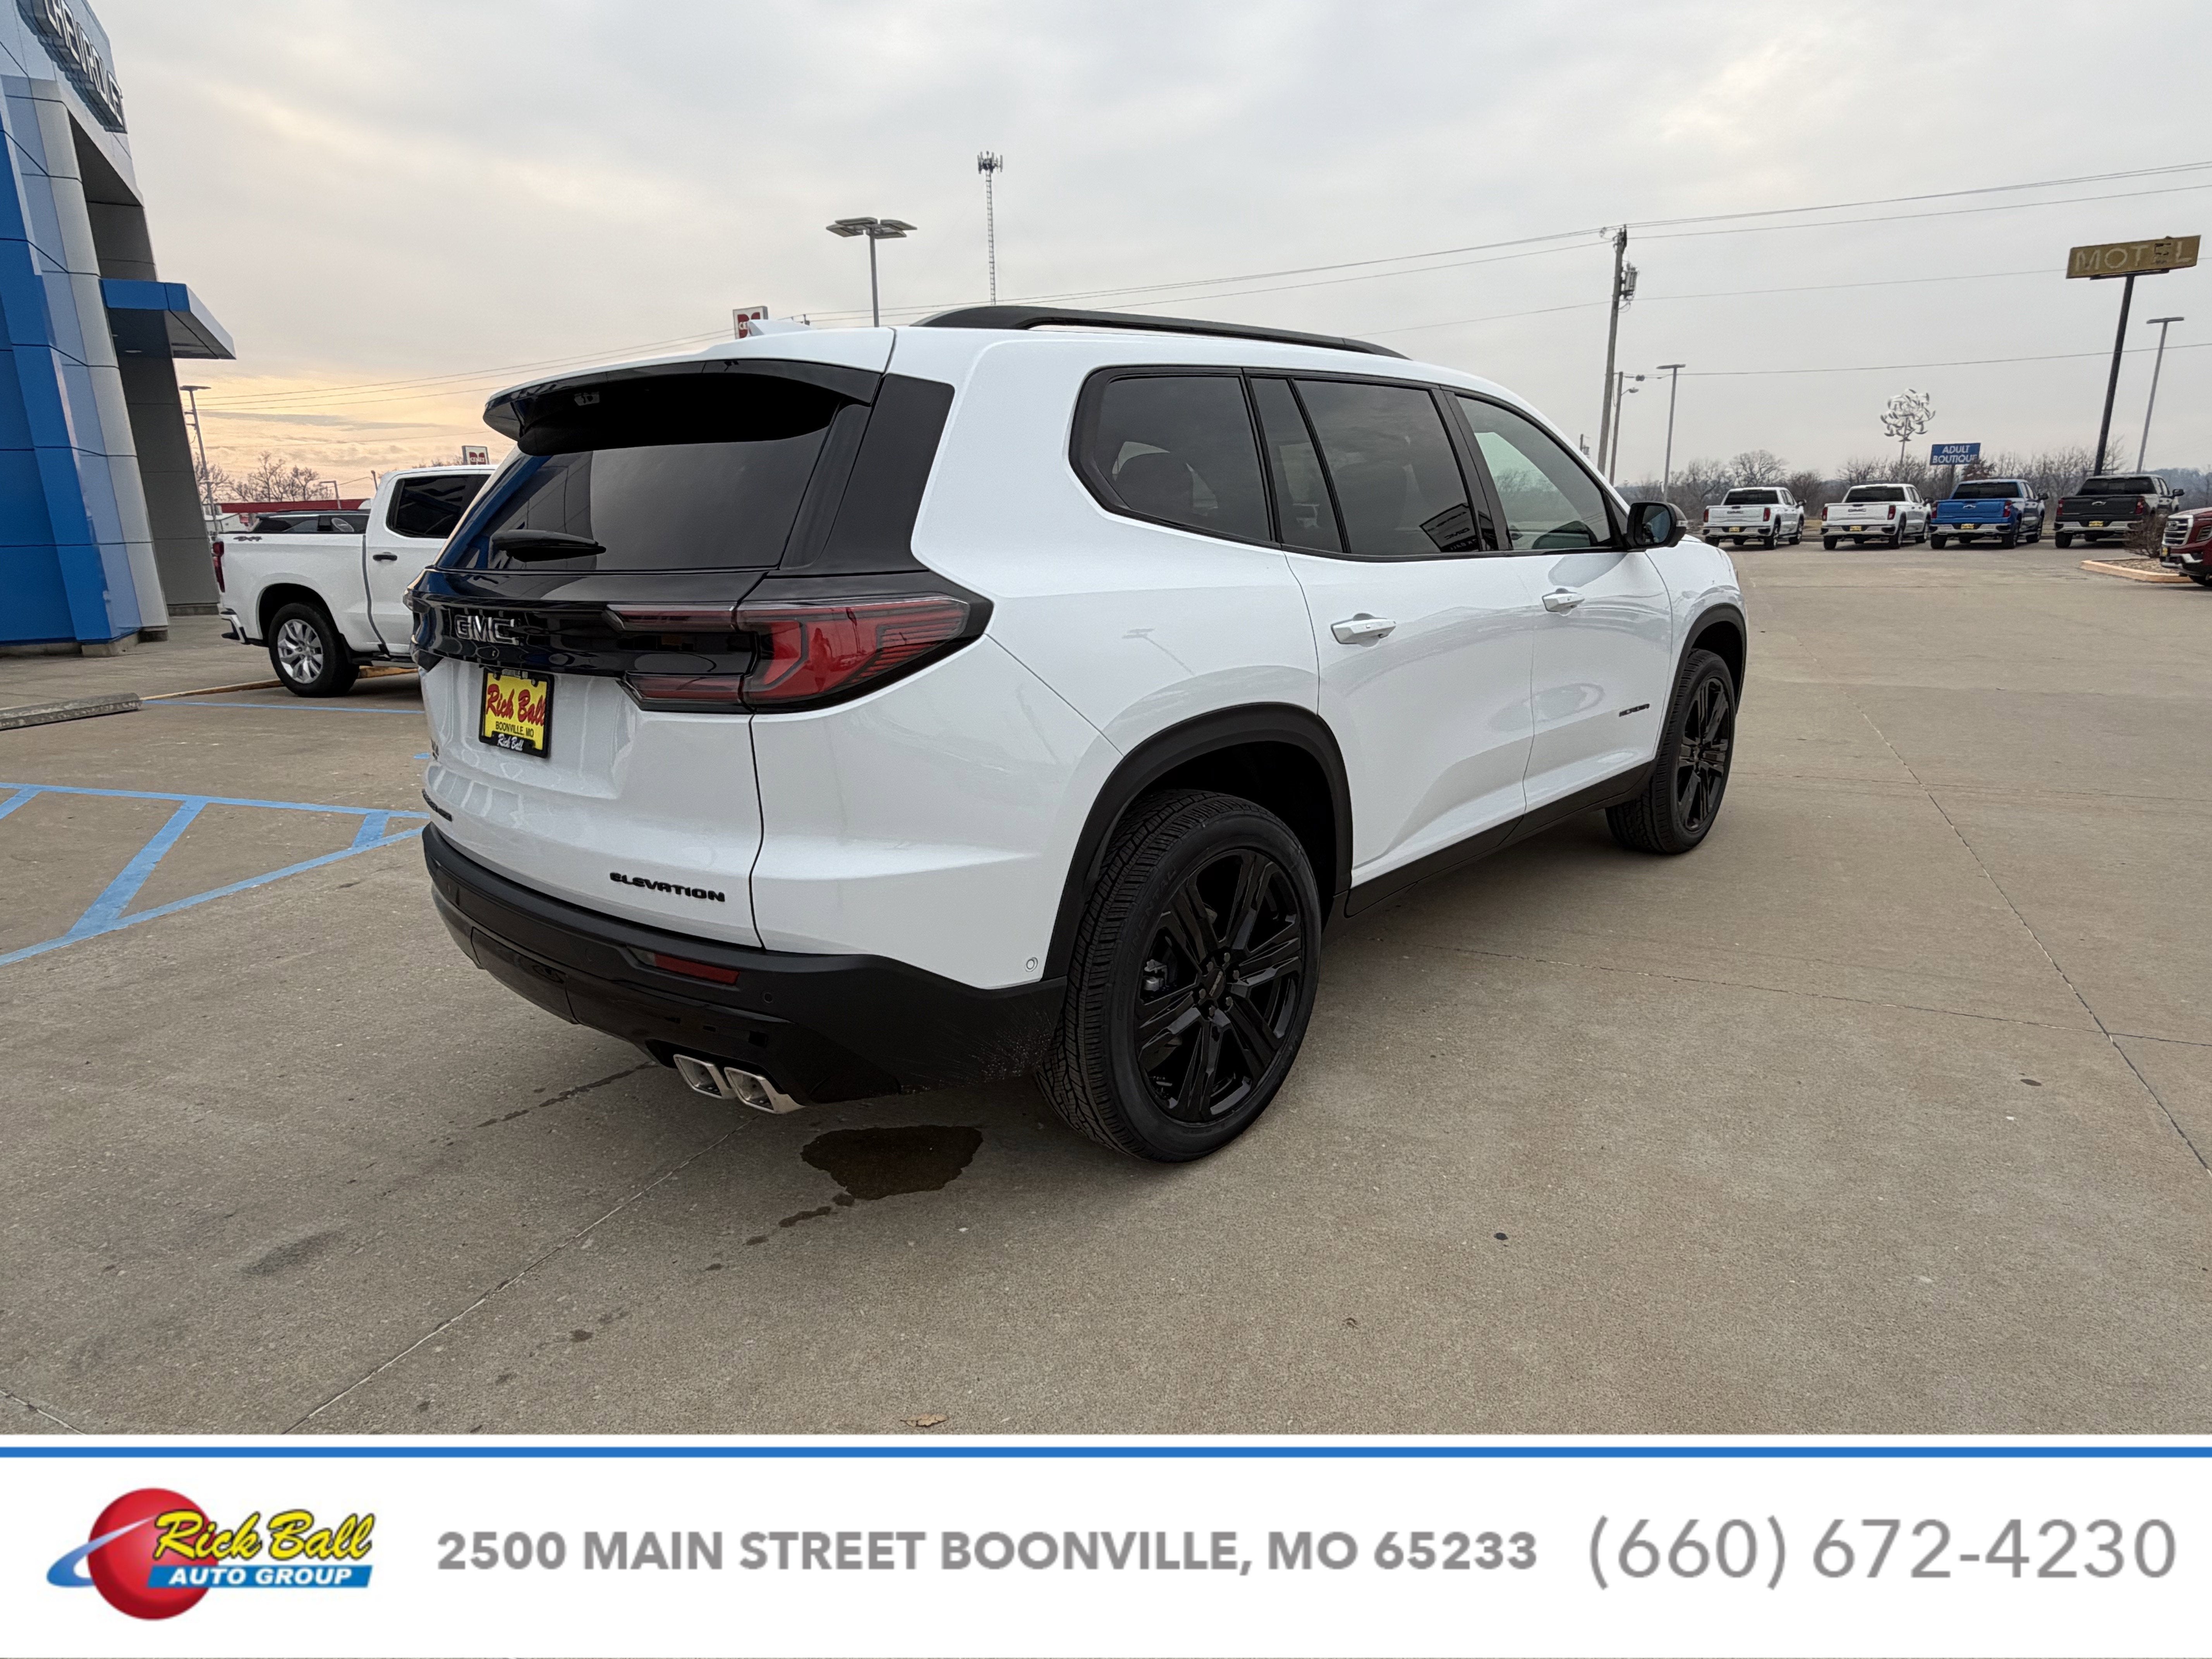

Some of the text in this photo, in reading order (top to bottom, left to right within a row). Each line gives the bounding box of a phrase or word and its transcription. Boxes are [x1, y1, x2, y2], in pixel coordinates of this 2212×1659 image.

[44, 0, 123, 128] HEVROLE
[2076, 241, 2193, 272] MOTEL
[1942, 445, 1970, 454] ADULT
[455, 615, 519, 645] GMC
[486, 684, 546, 727] Rick Ball
[497, 733, 524, 751] Rick Ball
[610, 872, 725, 902] ELEVATION
